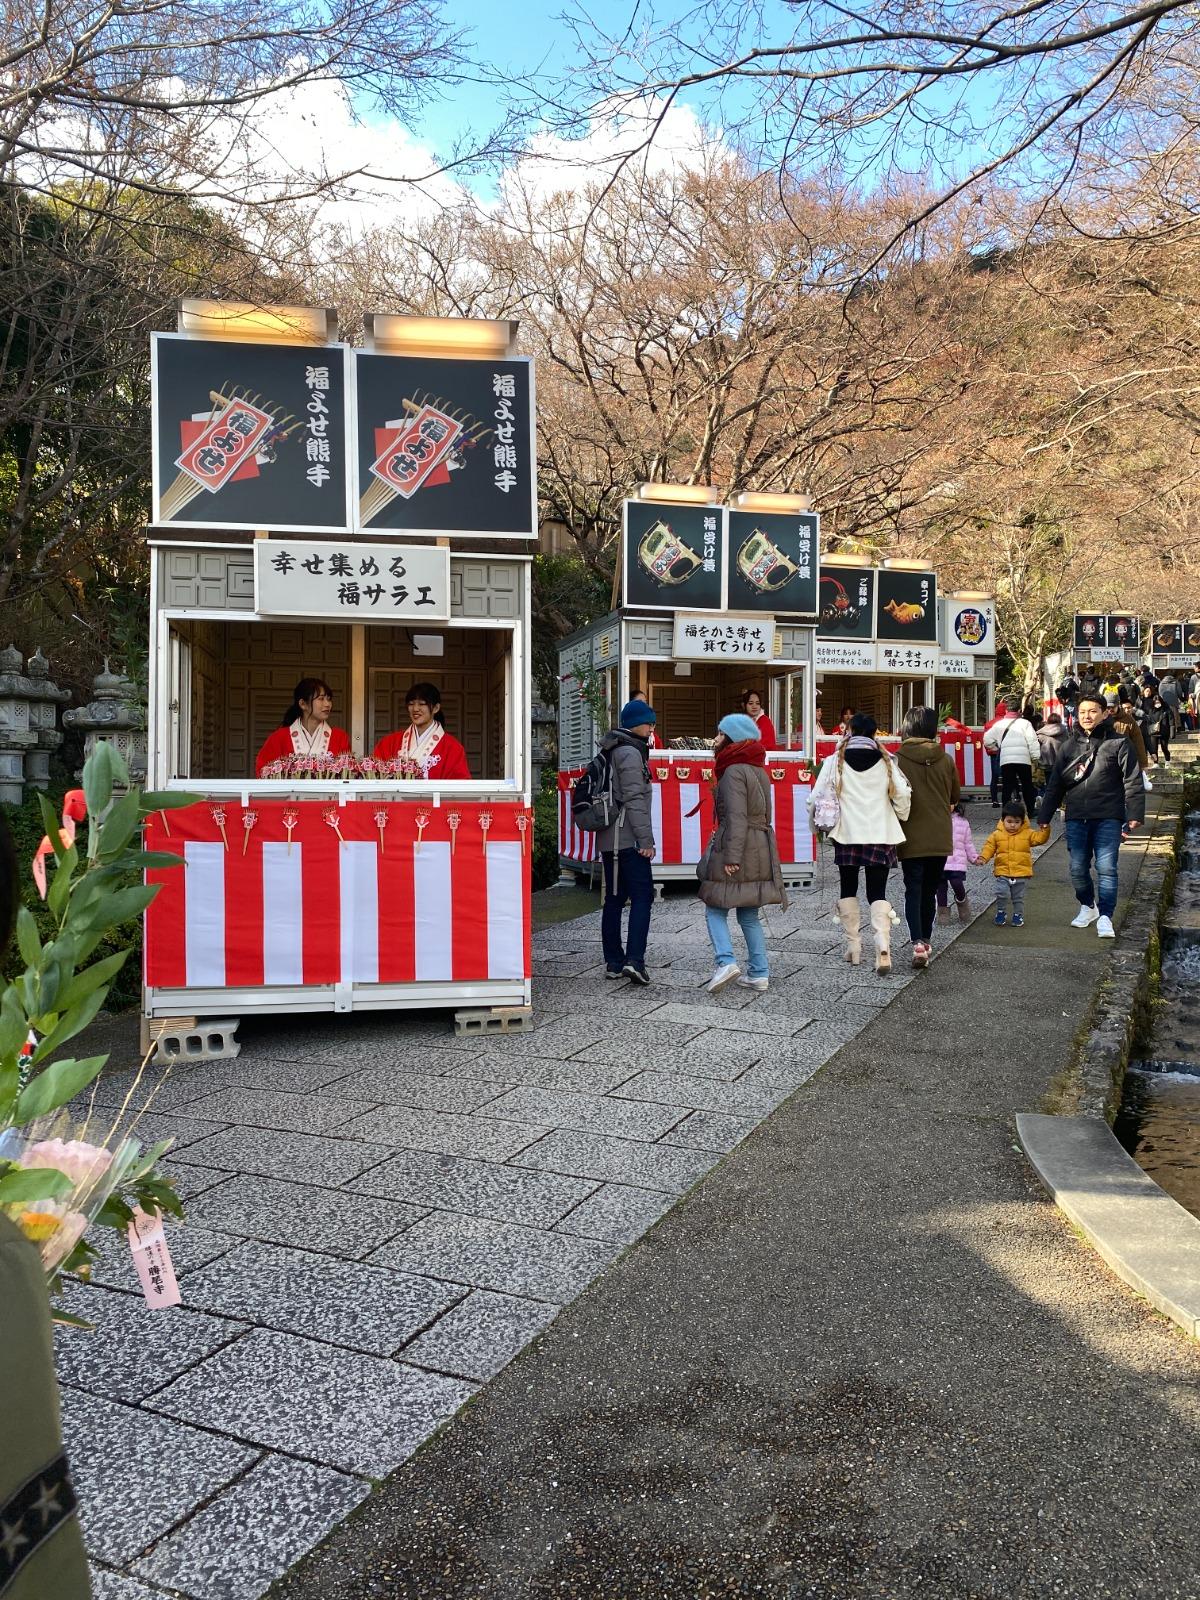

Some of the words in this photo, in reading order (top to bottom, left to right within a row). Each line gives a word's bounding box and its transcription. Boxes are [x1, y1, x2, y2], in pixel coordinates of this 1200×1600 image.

[305, 365, 331, 488] 福よせ熊手
[492, 373, 518, 493] 福よせ熊手
[270, 550, 408, 578] 幸せ集める
[337, 581, 436, 607] 福サラエ
[685, 624, 762, 638] 福をかき寄せ
[703, 639, 766, 654] 箕でうける
[906, 650, 922, 660] 幸せ
